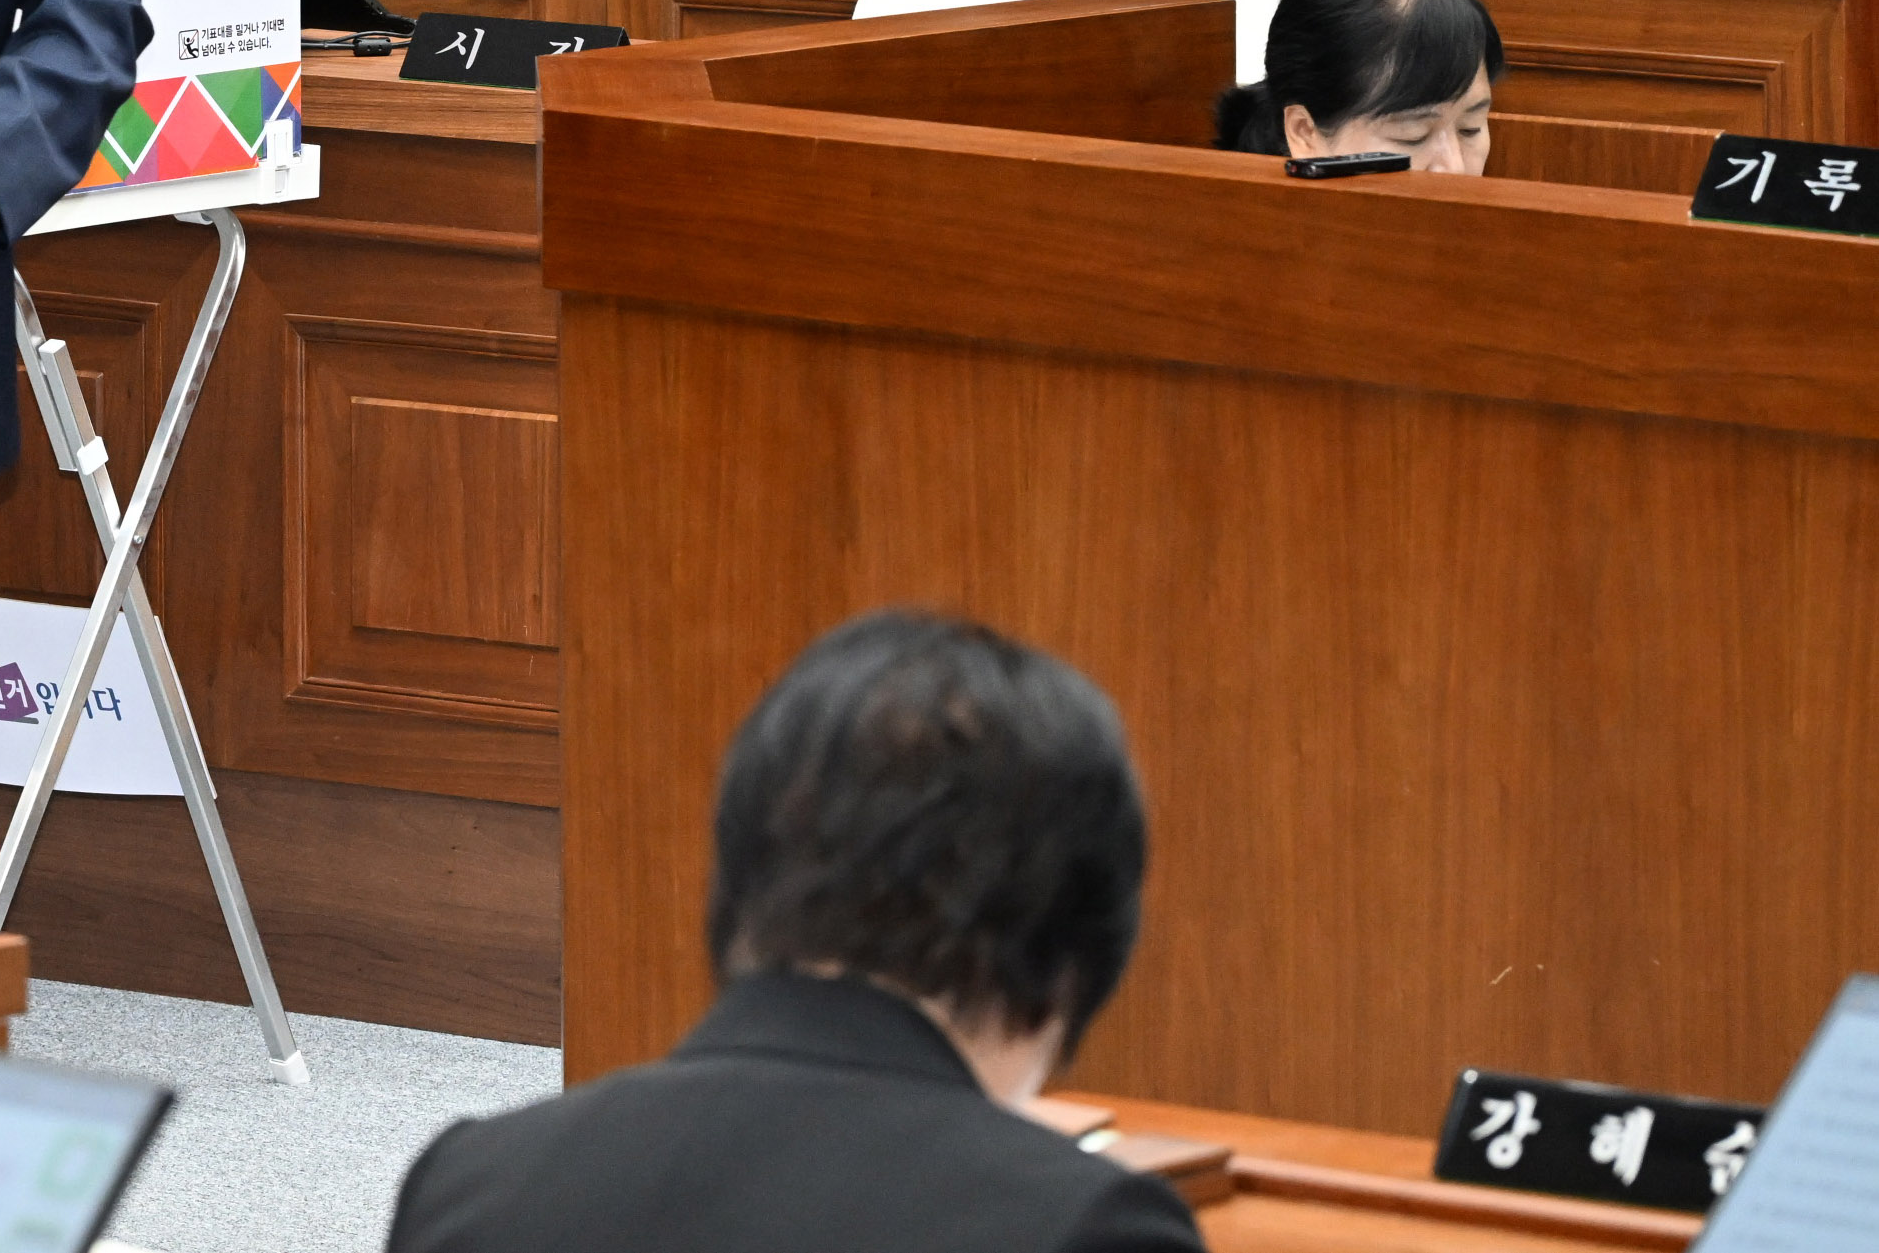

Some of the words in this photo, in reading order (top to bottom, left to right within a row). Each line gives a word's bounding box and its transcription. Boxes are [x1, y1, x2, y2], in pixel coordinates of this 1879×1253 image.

[201, 25, 234, 41] 기표대를
[235, 22, 260, 37] 밀거나
[261, 18, 285, 33] 기대면
[201, 42, 226, 57] 넘어질
[227, 41, 236, 54] 수
[237, 36, 272, 52] 있습니다.
